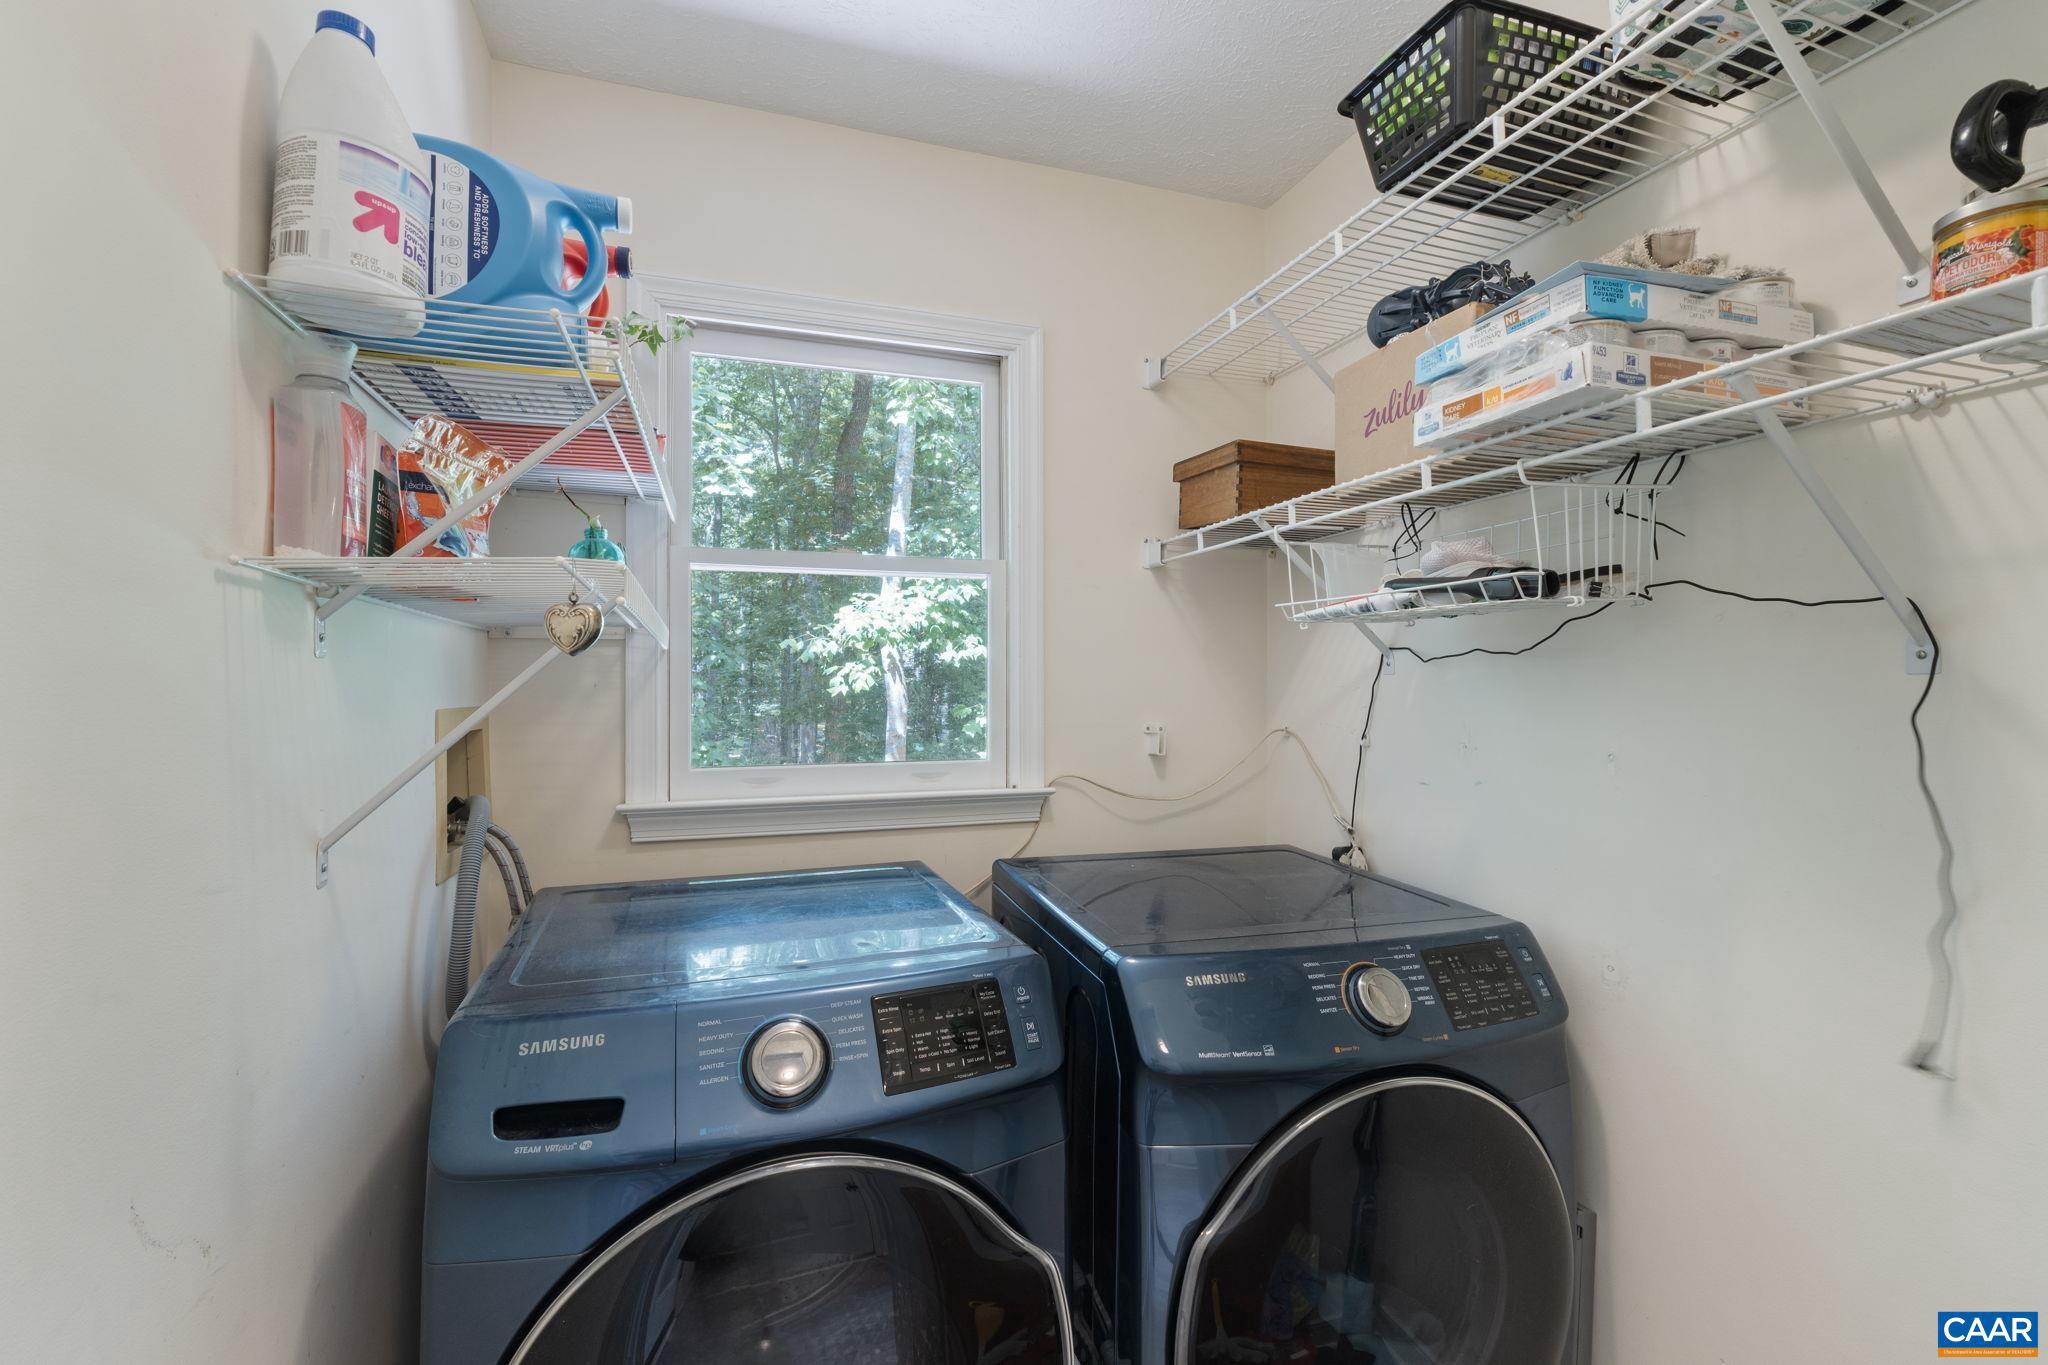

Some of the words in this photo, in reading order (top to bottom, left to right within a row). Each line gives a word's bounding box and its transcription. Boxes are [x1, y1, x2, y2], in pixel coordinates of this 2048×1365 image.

[481, 193, 489, 214] ADDS
[473, 203, 481, 247] FRESHNESS
[481, 215, 489, 255] SOFTNESS
[473, 249, 480, 259] TO
[1962, 252, 1996, 270] ODOR
[1593, 285, 1624, 294] FUNCTION
[1602, 281, 1623, 289] KIDNEY
[1592, 291, 1624, 299] ADVANCED
[1504, 311, 1519, 327] NF
[1363, 379, 1427, 438] zulily
[1445, 401, 1467, 414] KIDNEY
[1185, 972, 1247, 987] SAMSUNG
[698, 1019, 722, 1027] NORMAL
[838, 1025, 865, 1034] DELICATES
[698, 1034, 718, 1043] HEAVY
[519, 1033, 605, 1056] SAMSUNG
[698, 1047, 725, 1056] BEDDING
[699, 1062, 726, 1071] SANITIZE
[699, 1075, 729, 1086] ALLERGEN
[513, 1145, 541, 1154] STEAM
